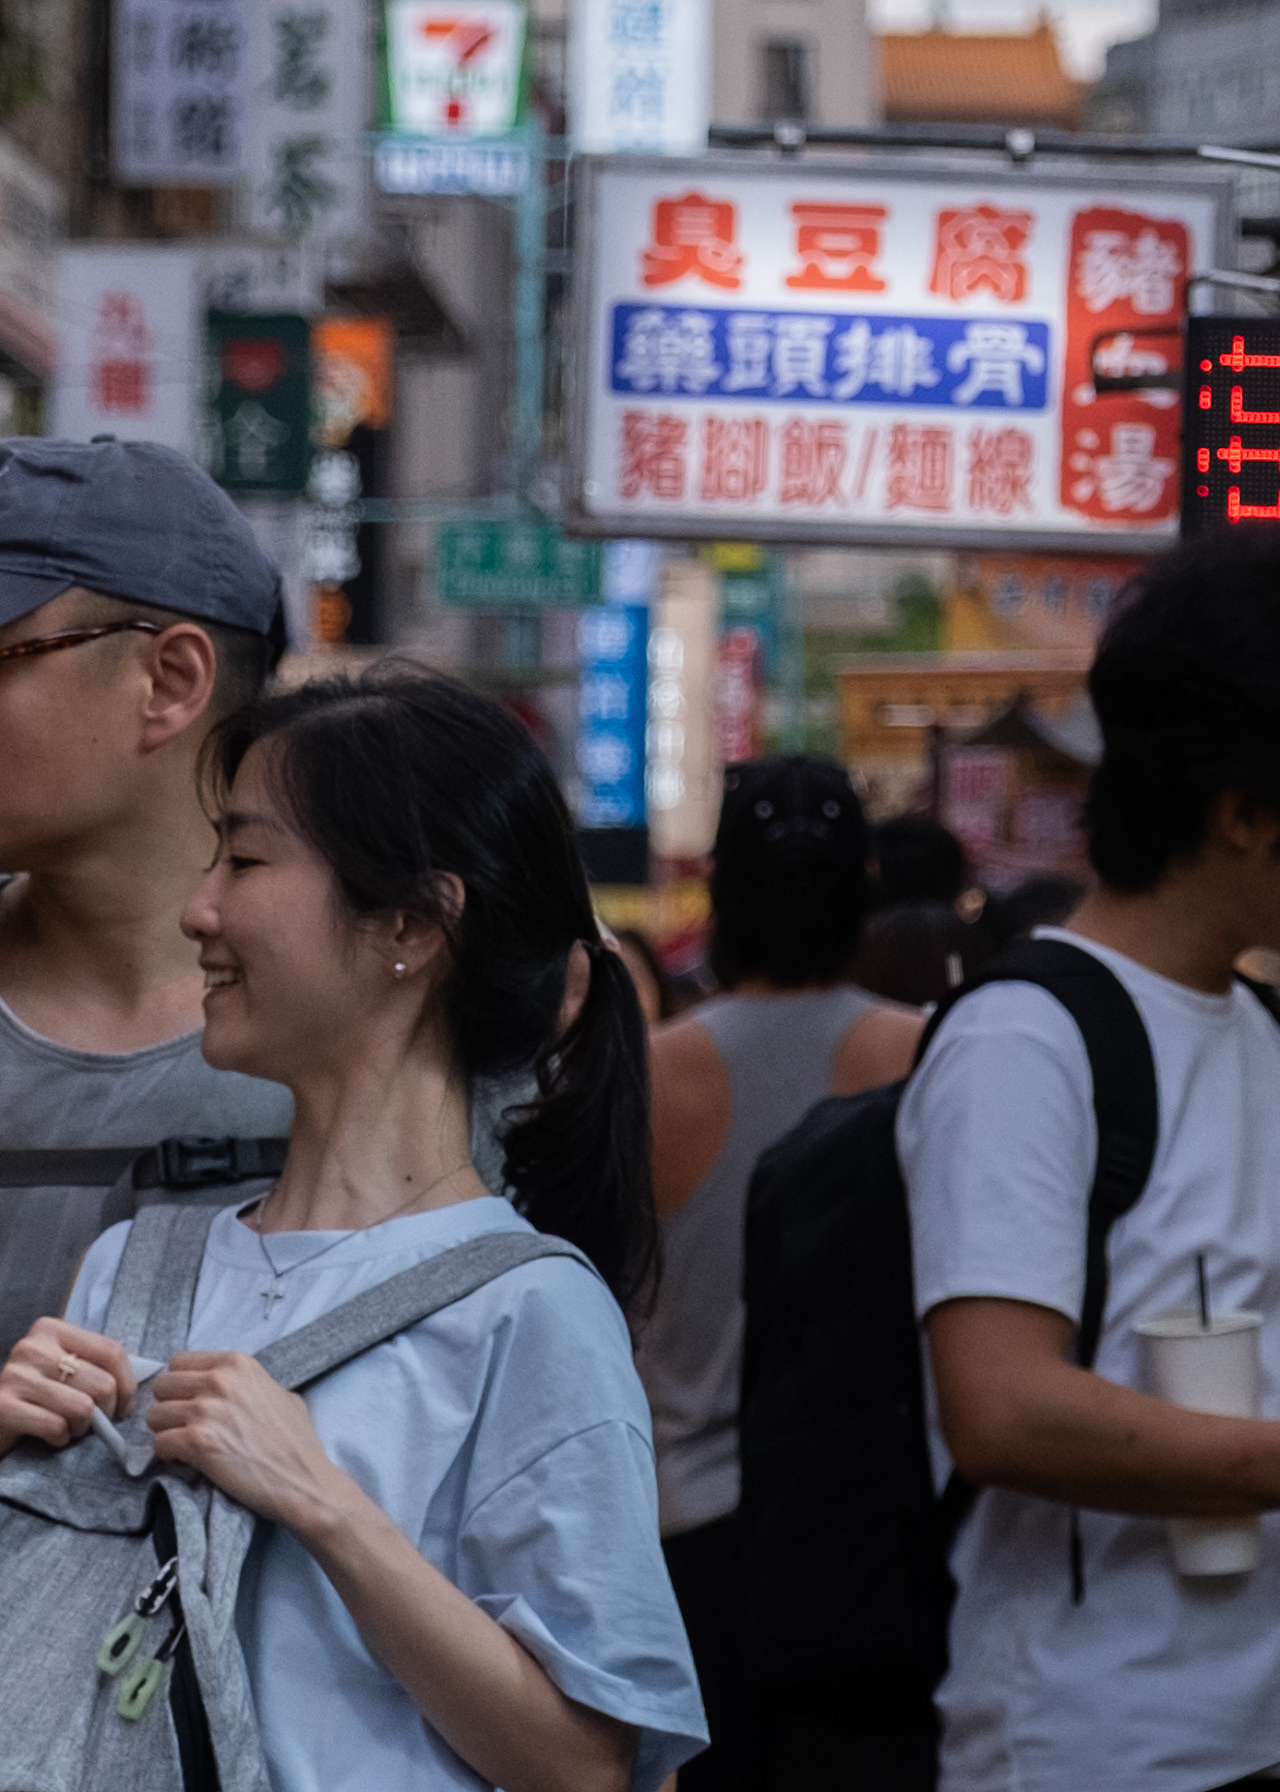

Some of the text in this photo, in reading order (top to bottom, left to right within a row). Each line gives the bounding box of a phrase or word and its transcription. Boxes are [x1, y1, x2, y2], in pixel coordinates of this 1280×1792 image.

[640, 192, 1037, 302] 臭豆腐
[615, 309, 1044, 407] 藥頭排骨
